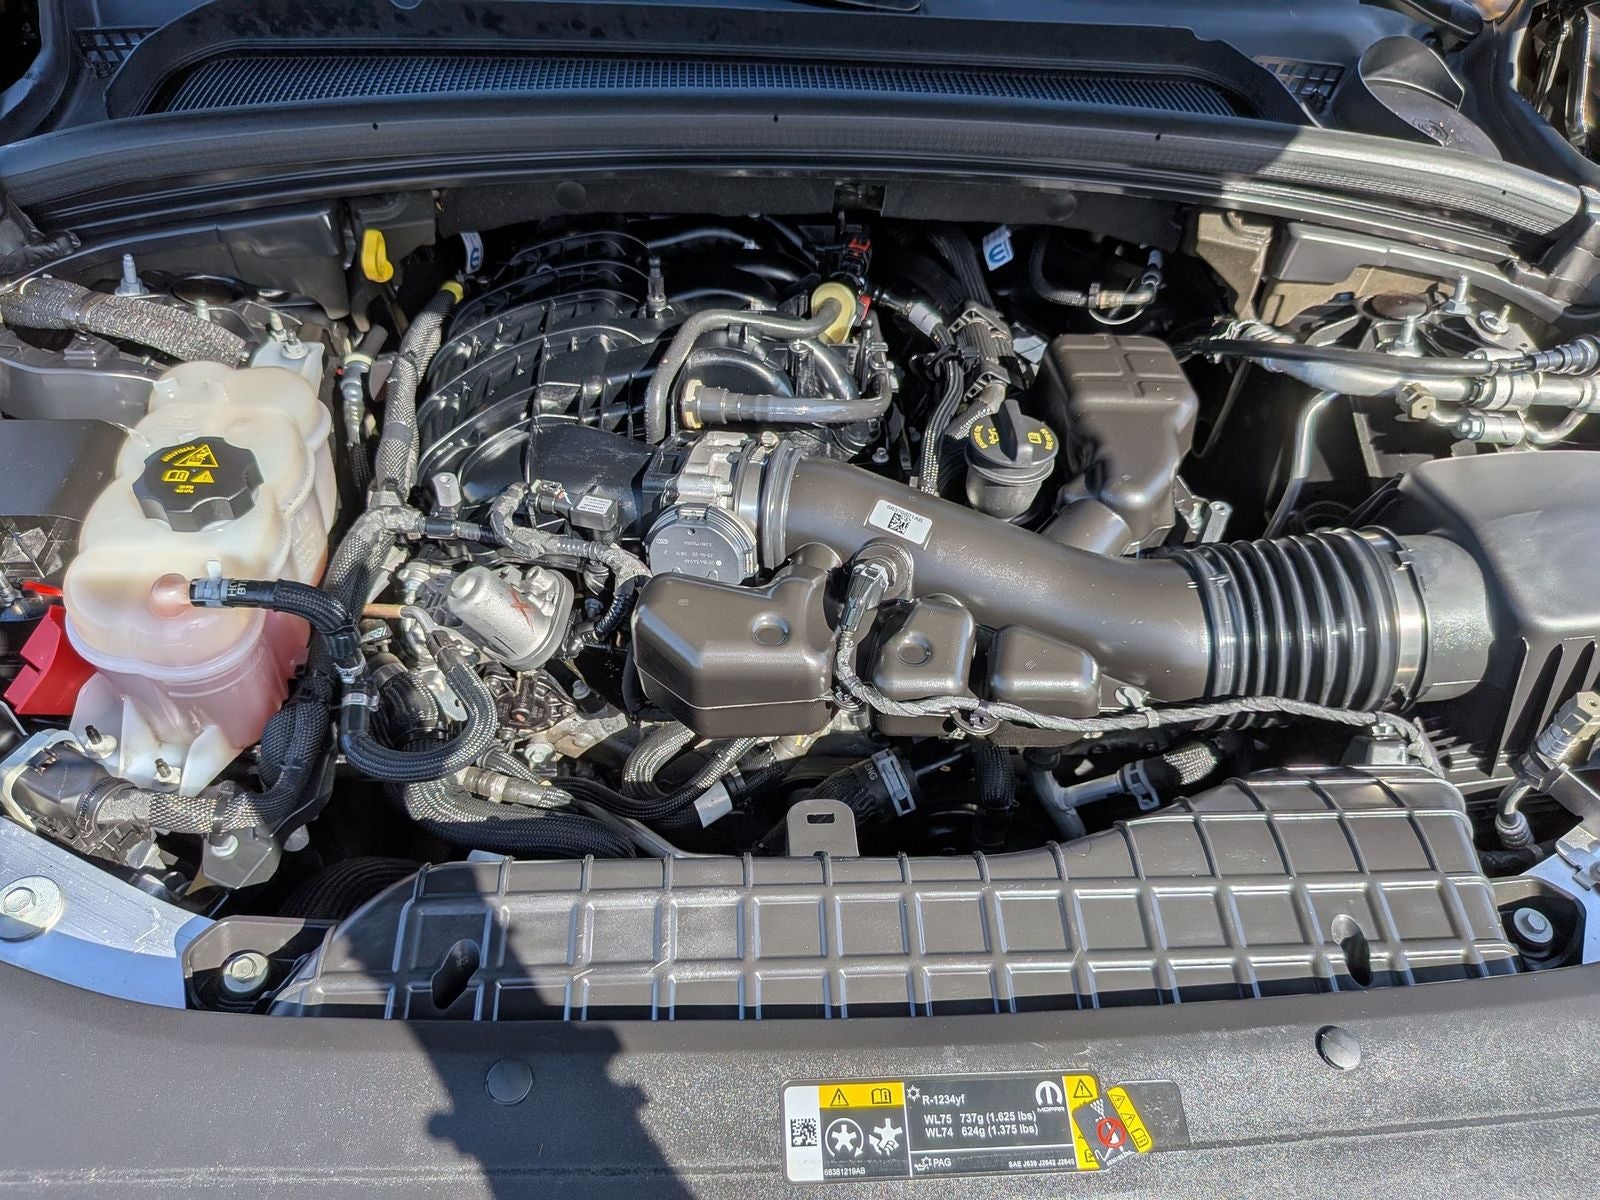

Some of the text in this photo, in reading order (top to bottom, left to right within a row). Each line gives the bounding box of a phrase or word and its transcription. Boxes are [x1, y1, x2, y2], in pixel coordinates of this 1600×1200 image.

[864, 762, 878, 780] ENG
[922, 1093, 965, 1107] R-1234yf
[924, 1110, 1037, 1126] WL75 737g (1.625 lbs)
[925, 1123, 1039, 1139] WL74 624g (1.375 lbs)
[933, 1158, 952, 1168] PAG
[1008, 1160, 1022, 1168] SAE
